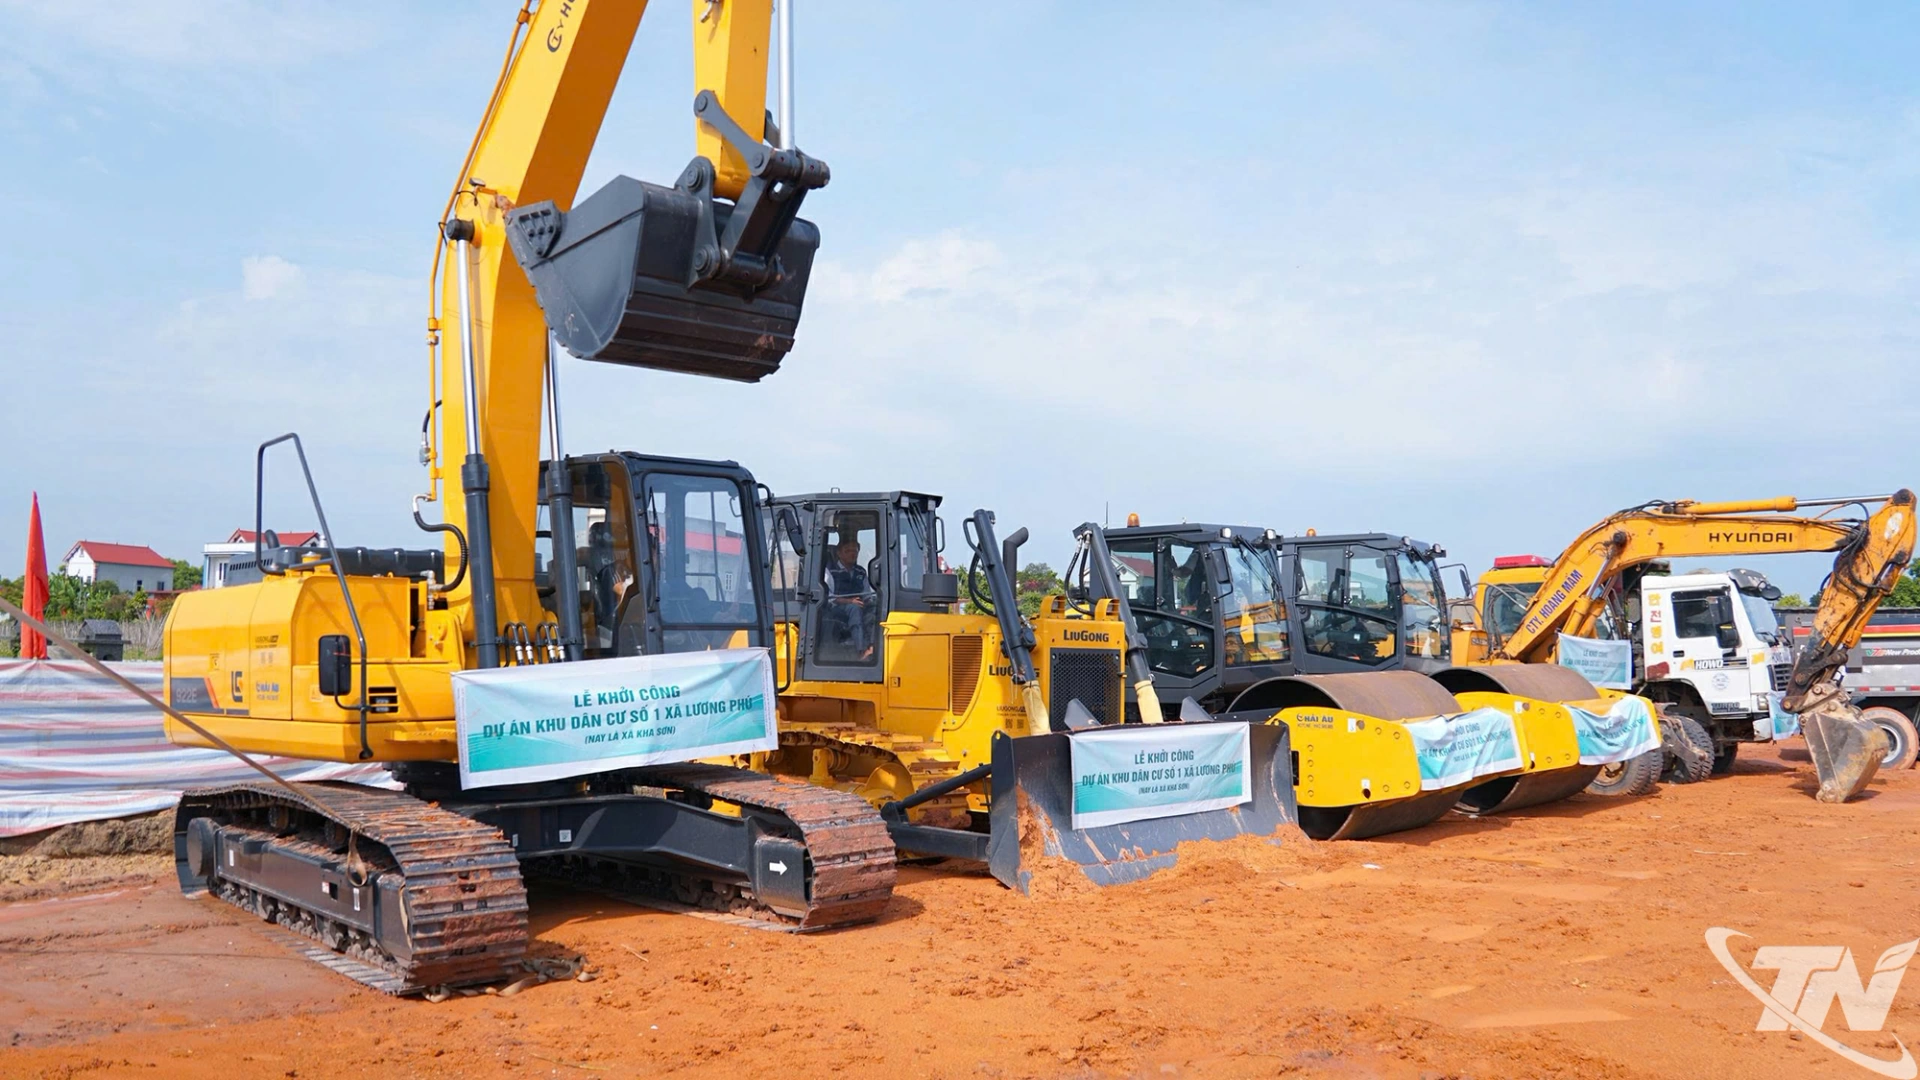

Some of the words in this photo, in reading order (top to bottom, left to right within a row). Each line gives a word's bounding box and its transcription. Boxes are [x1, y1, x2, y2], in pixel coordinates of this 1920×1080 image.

[560, 0, 577, 18] H
[1709, 532, 1793, 543] HYUNDAI
[1695, 659, 1724, 670] HOWO
[574, 689, 592, 708] LỄ
[597, 686, 635, 706] KHỞI
[639, 684, 680, 702] CÔNG
[483, 721, 505, 740] DỰ
[509, 719, 531, 736] ÁN
[536, 717, 566, 733] KHU
[571, 712, 601, 730] DÂN
[606, 710, 627, 726] CƯ
[630, 704, 649, 723] SỐ
[654, 708, 660, 721] 1
[665, 703, 683, 720] XÃ
[686, 700, 726, 718] LƯƠNG
[729, 695, 753, 712] PHÚ
[584, 732, 606, 744] (NAY
[636, 728, 655, 739] KHA
[656, 725, 676, 736] SƠN)
[1147, 748, 1168, 763] KHỞI
[1171, 748, 1194, 762] CÔNG
[1082, 772, 1096, 788] DỰ
[1097, 770, 1110, 785] ÁN
[1112, 771, 1130, 784] KHU
[1131, 768, 1149, 782] DÂN
[1151, 768, 1163, 780] CƯ
[1164, 764, 1176, 779] SỐ
[1177, 767, 1182, 779] 1
[1196, 763, 1220, 777] LƯƠNG
